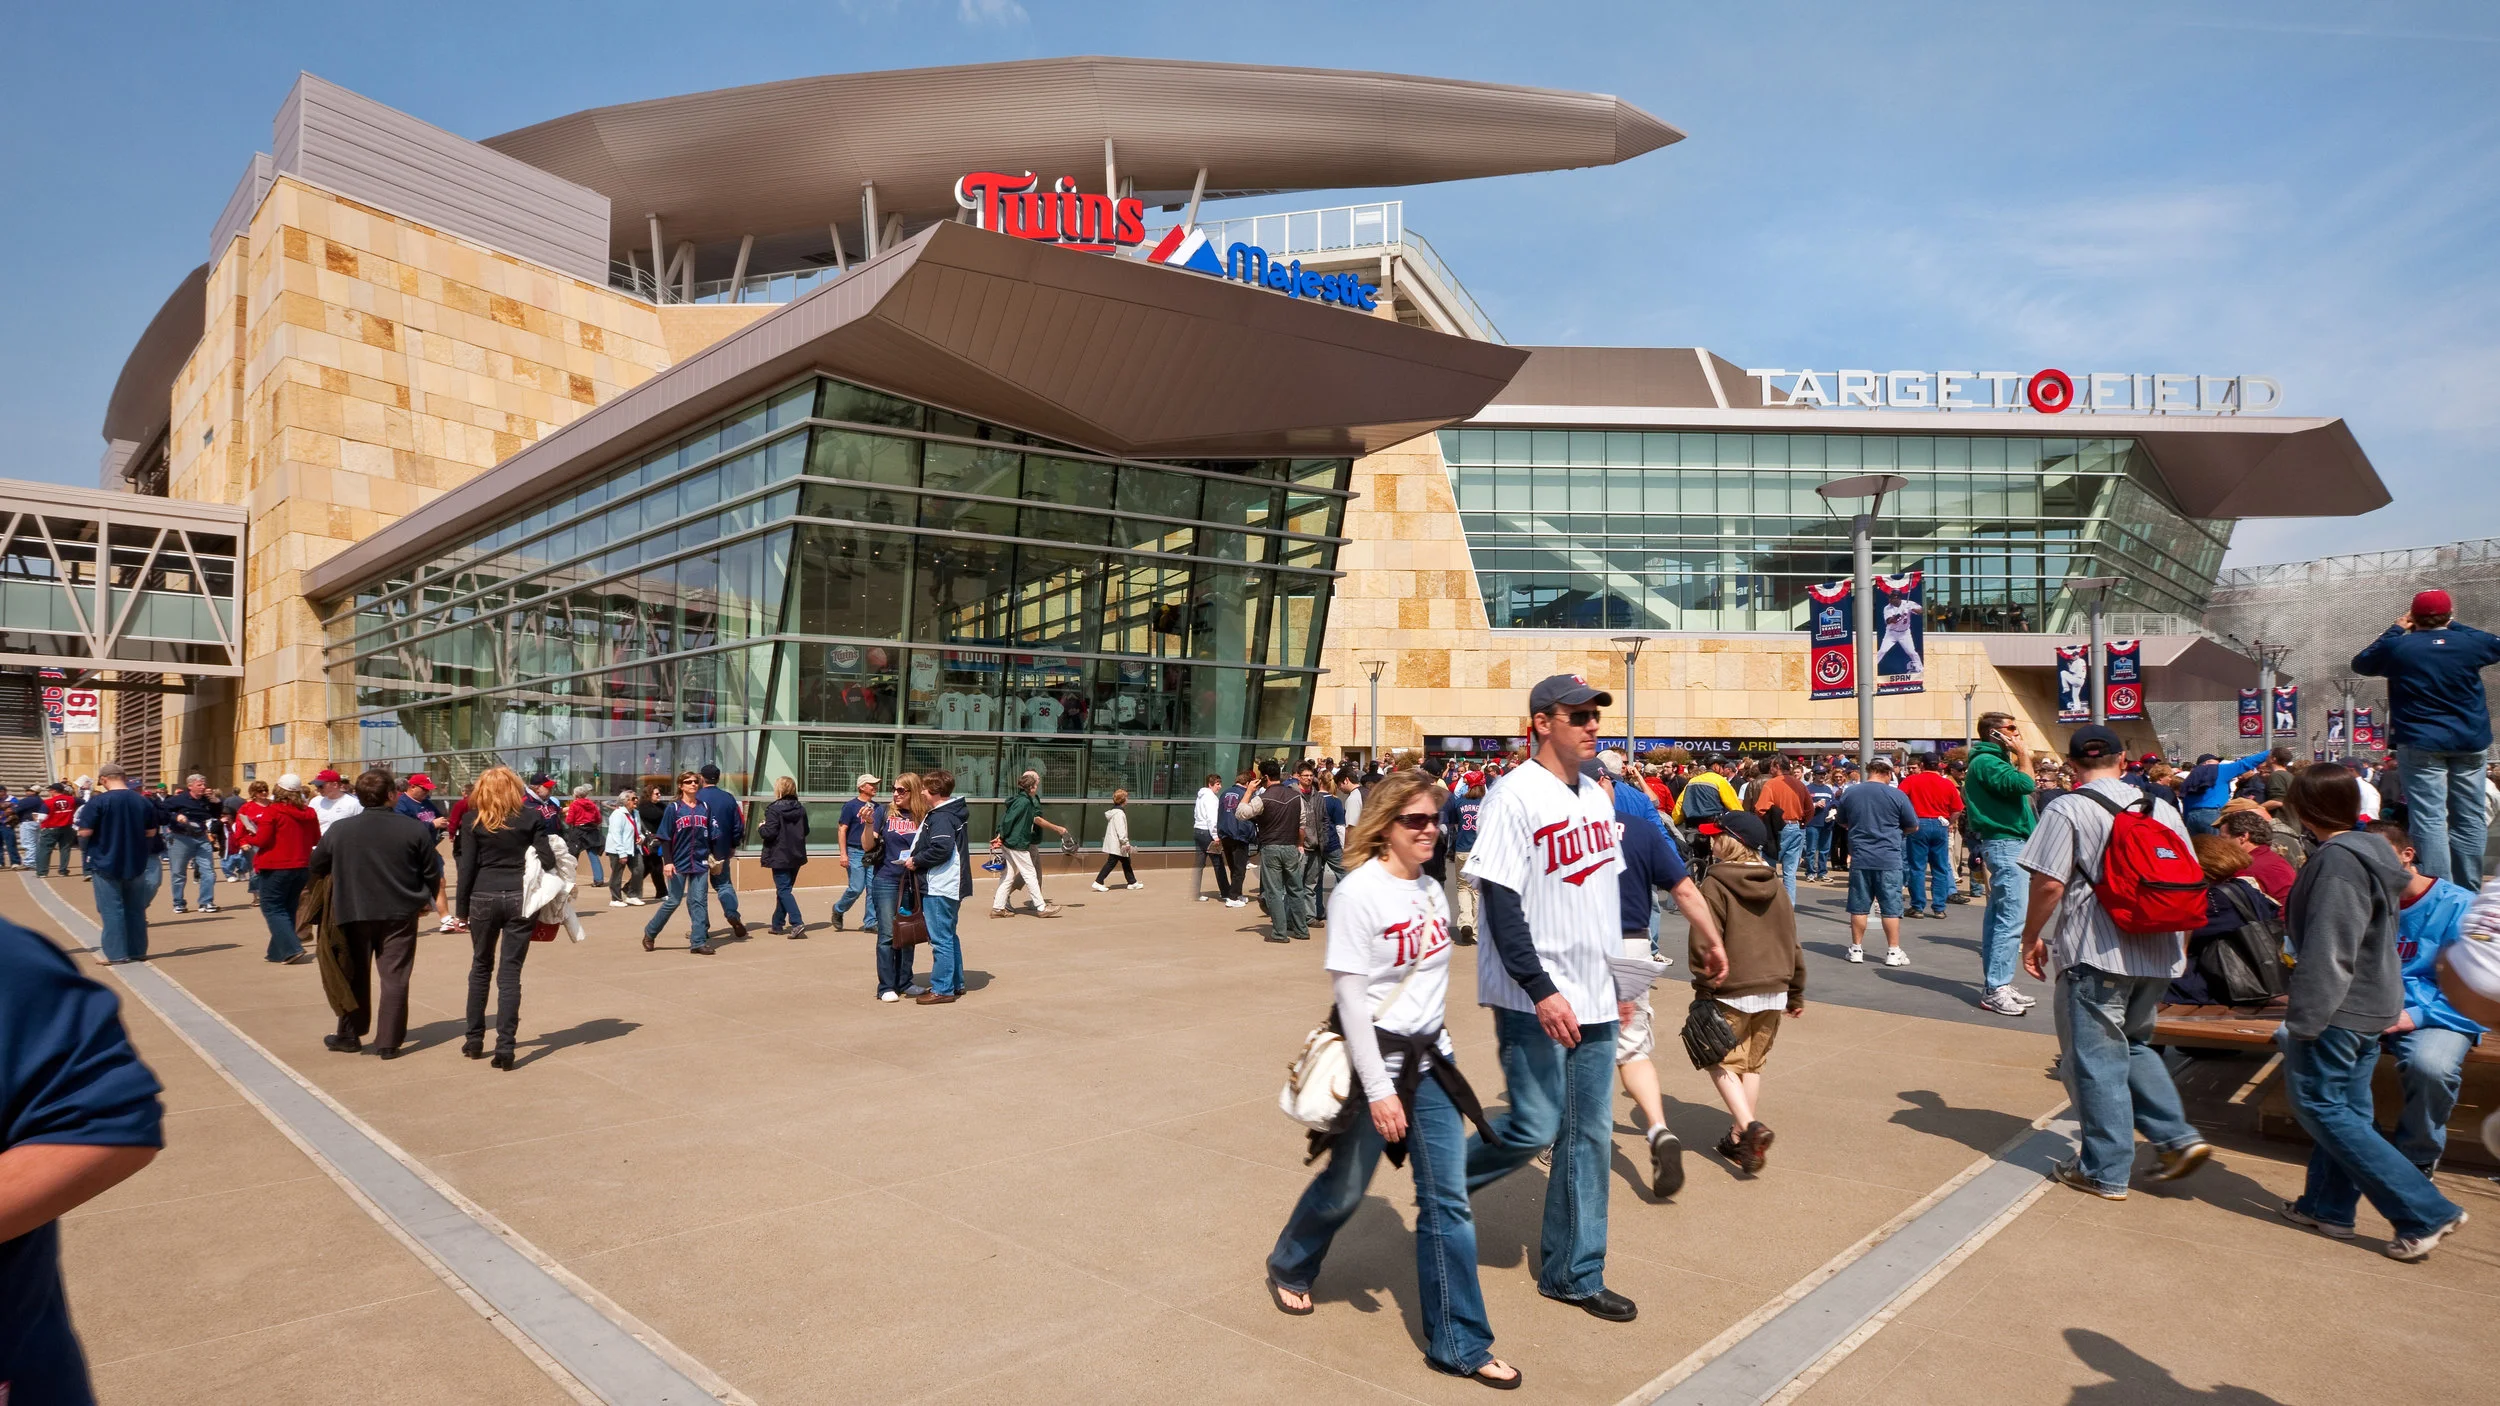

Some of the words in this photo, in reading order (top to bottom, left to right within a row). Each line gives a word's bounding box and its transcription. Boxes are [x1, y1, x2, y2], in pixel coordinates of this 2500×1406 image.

[955, 170, 1146, 246] Twins
[1227, 242, 1378, 311] Majestic
[1747, 369, 2018, 408] TARGET
[2088, 373, 2282, 412] FIELD
[1825, 662, 1840, 675] 50
[1889, 674, 1911, 682] SPAN
[1039, 707, 1051, 717] 36
[1674, 741, 1731, 751] ROYALS
[1738, 741, 1779, 752] APRIL
[1875, 741, 1897, 749] BEER
[676, 815, 708, 832] TWIN
[887, 815, 918, 833] Twin
[1533, 815, 1615, 876] Twins
